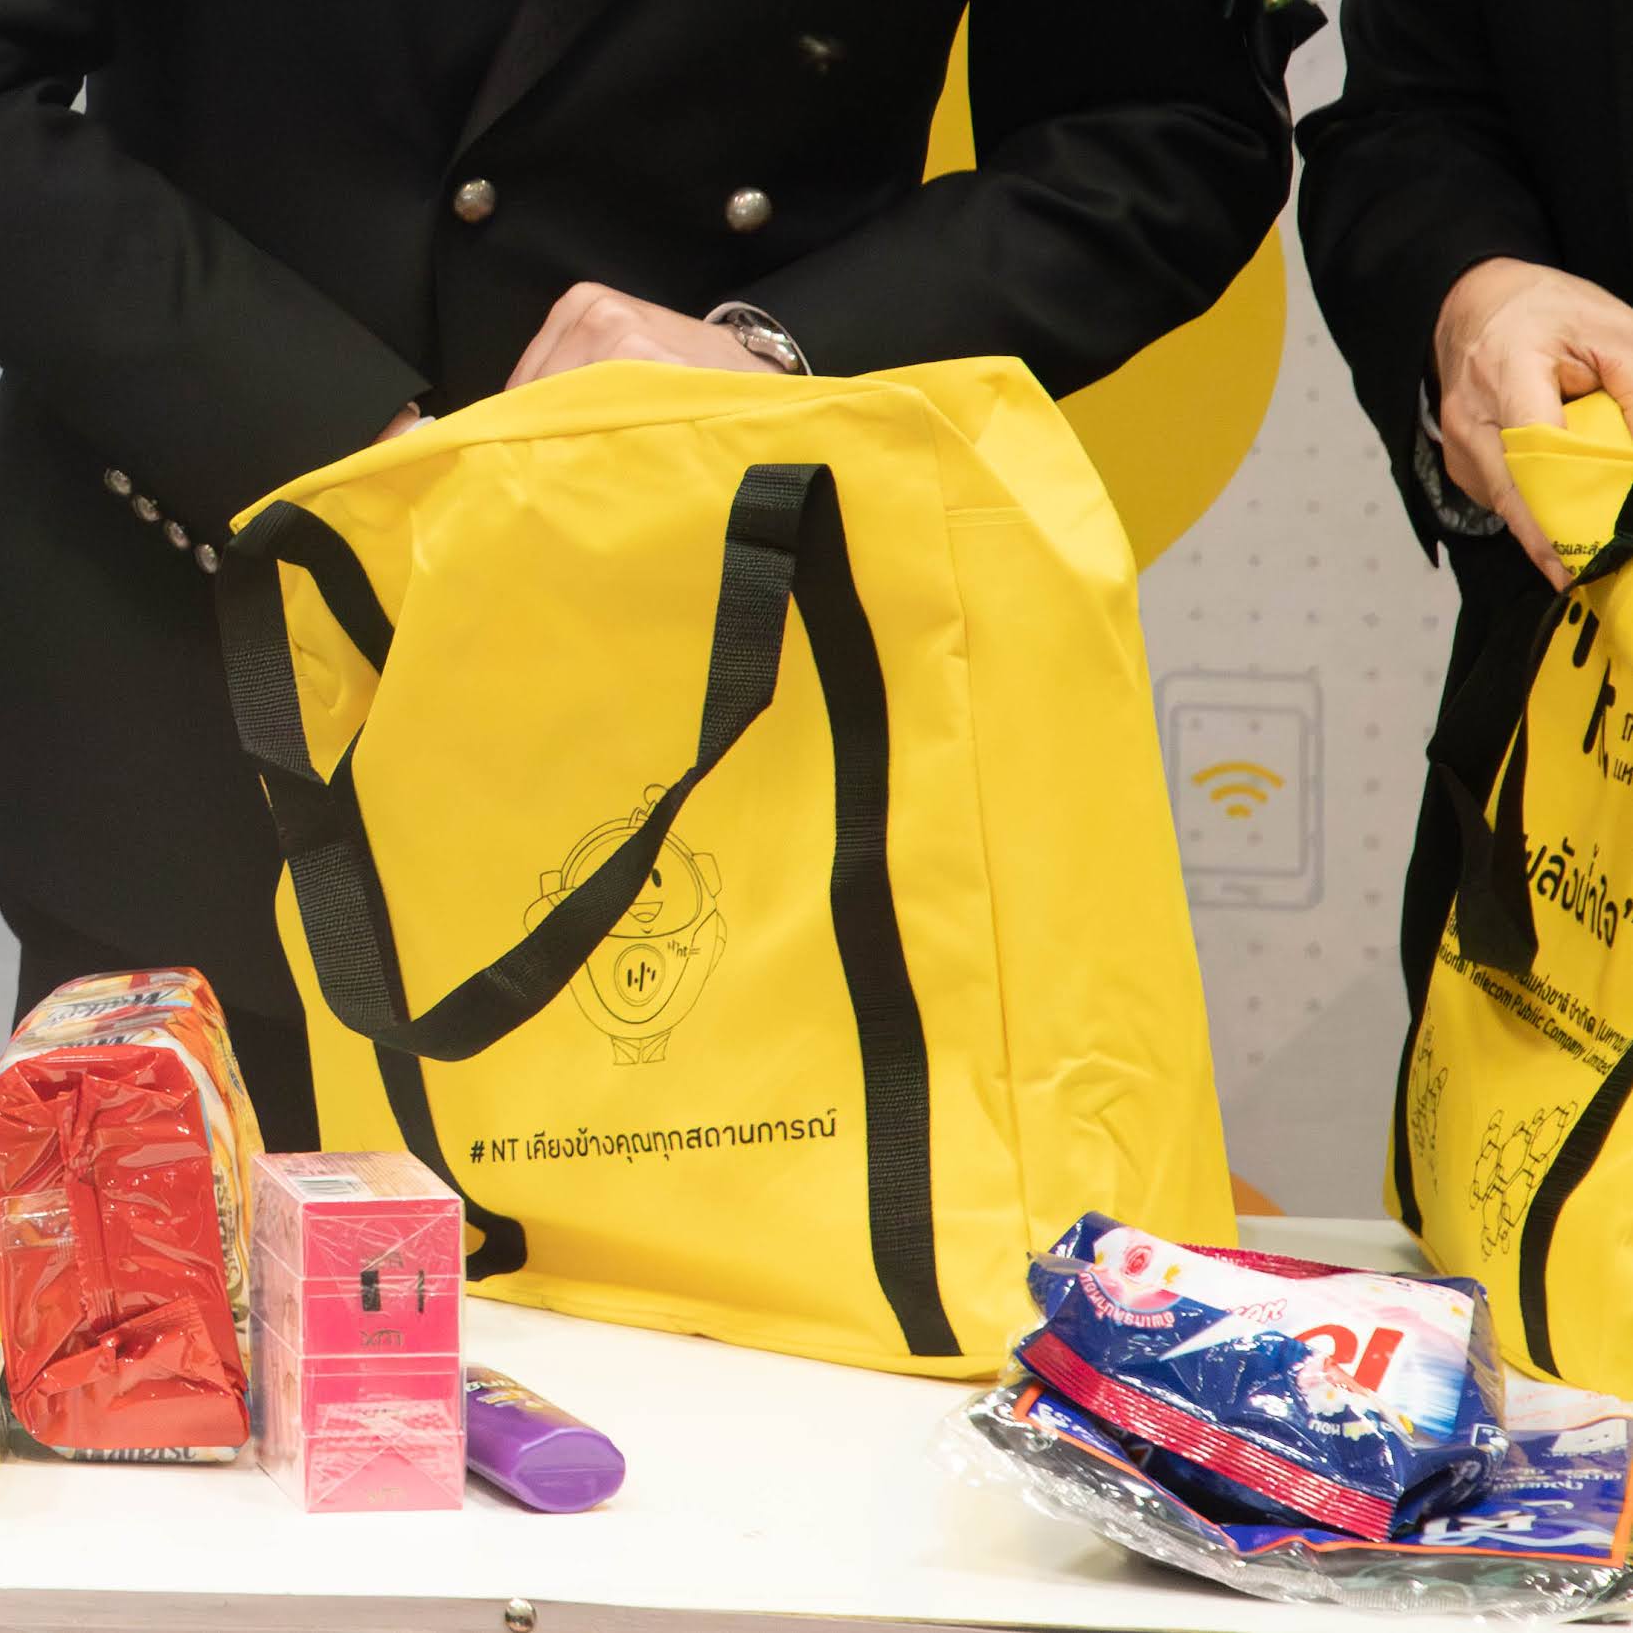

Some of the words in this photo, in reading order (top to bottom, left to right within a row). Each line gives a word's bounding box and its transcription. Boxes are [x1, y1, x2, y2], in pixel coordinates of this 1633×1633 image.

[1469, 963, 1514, 1008] Telecom
[1511, 994, 1546, 1031] Public
[1542, 1017, 1586, 1061] Company
[491, 1138, 520, 1162] NT
[525, 1107, 839, 1164] เคียงข้างคุณทุกสถานการณ์
